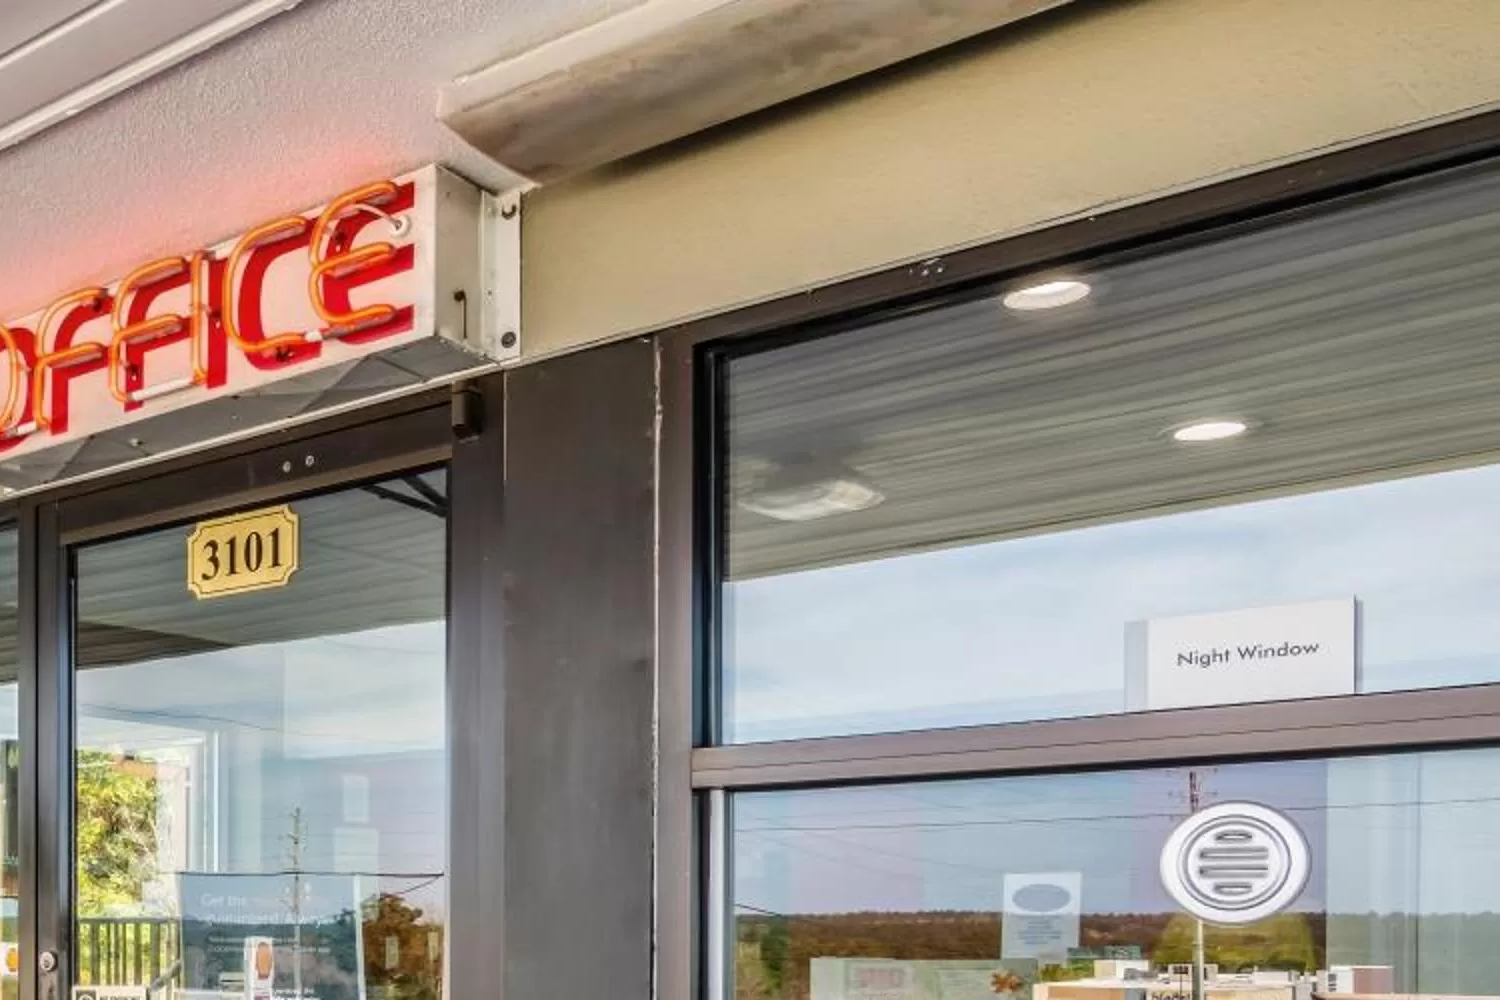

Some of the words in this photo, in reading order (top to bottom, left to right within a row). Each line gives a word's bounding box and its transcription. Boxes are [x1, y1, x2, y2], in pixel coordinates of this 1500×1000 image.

[201, 527, 284, 581] 3101
[1176, 649, 1230, 669] Night
[1236, 641, 1320, 661] Window
